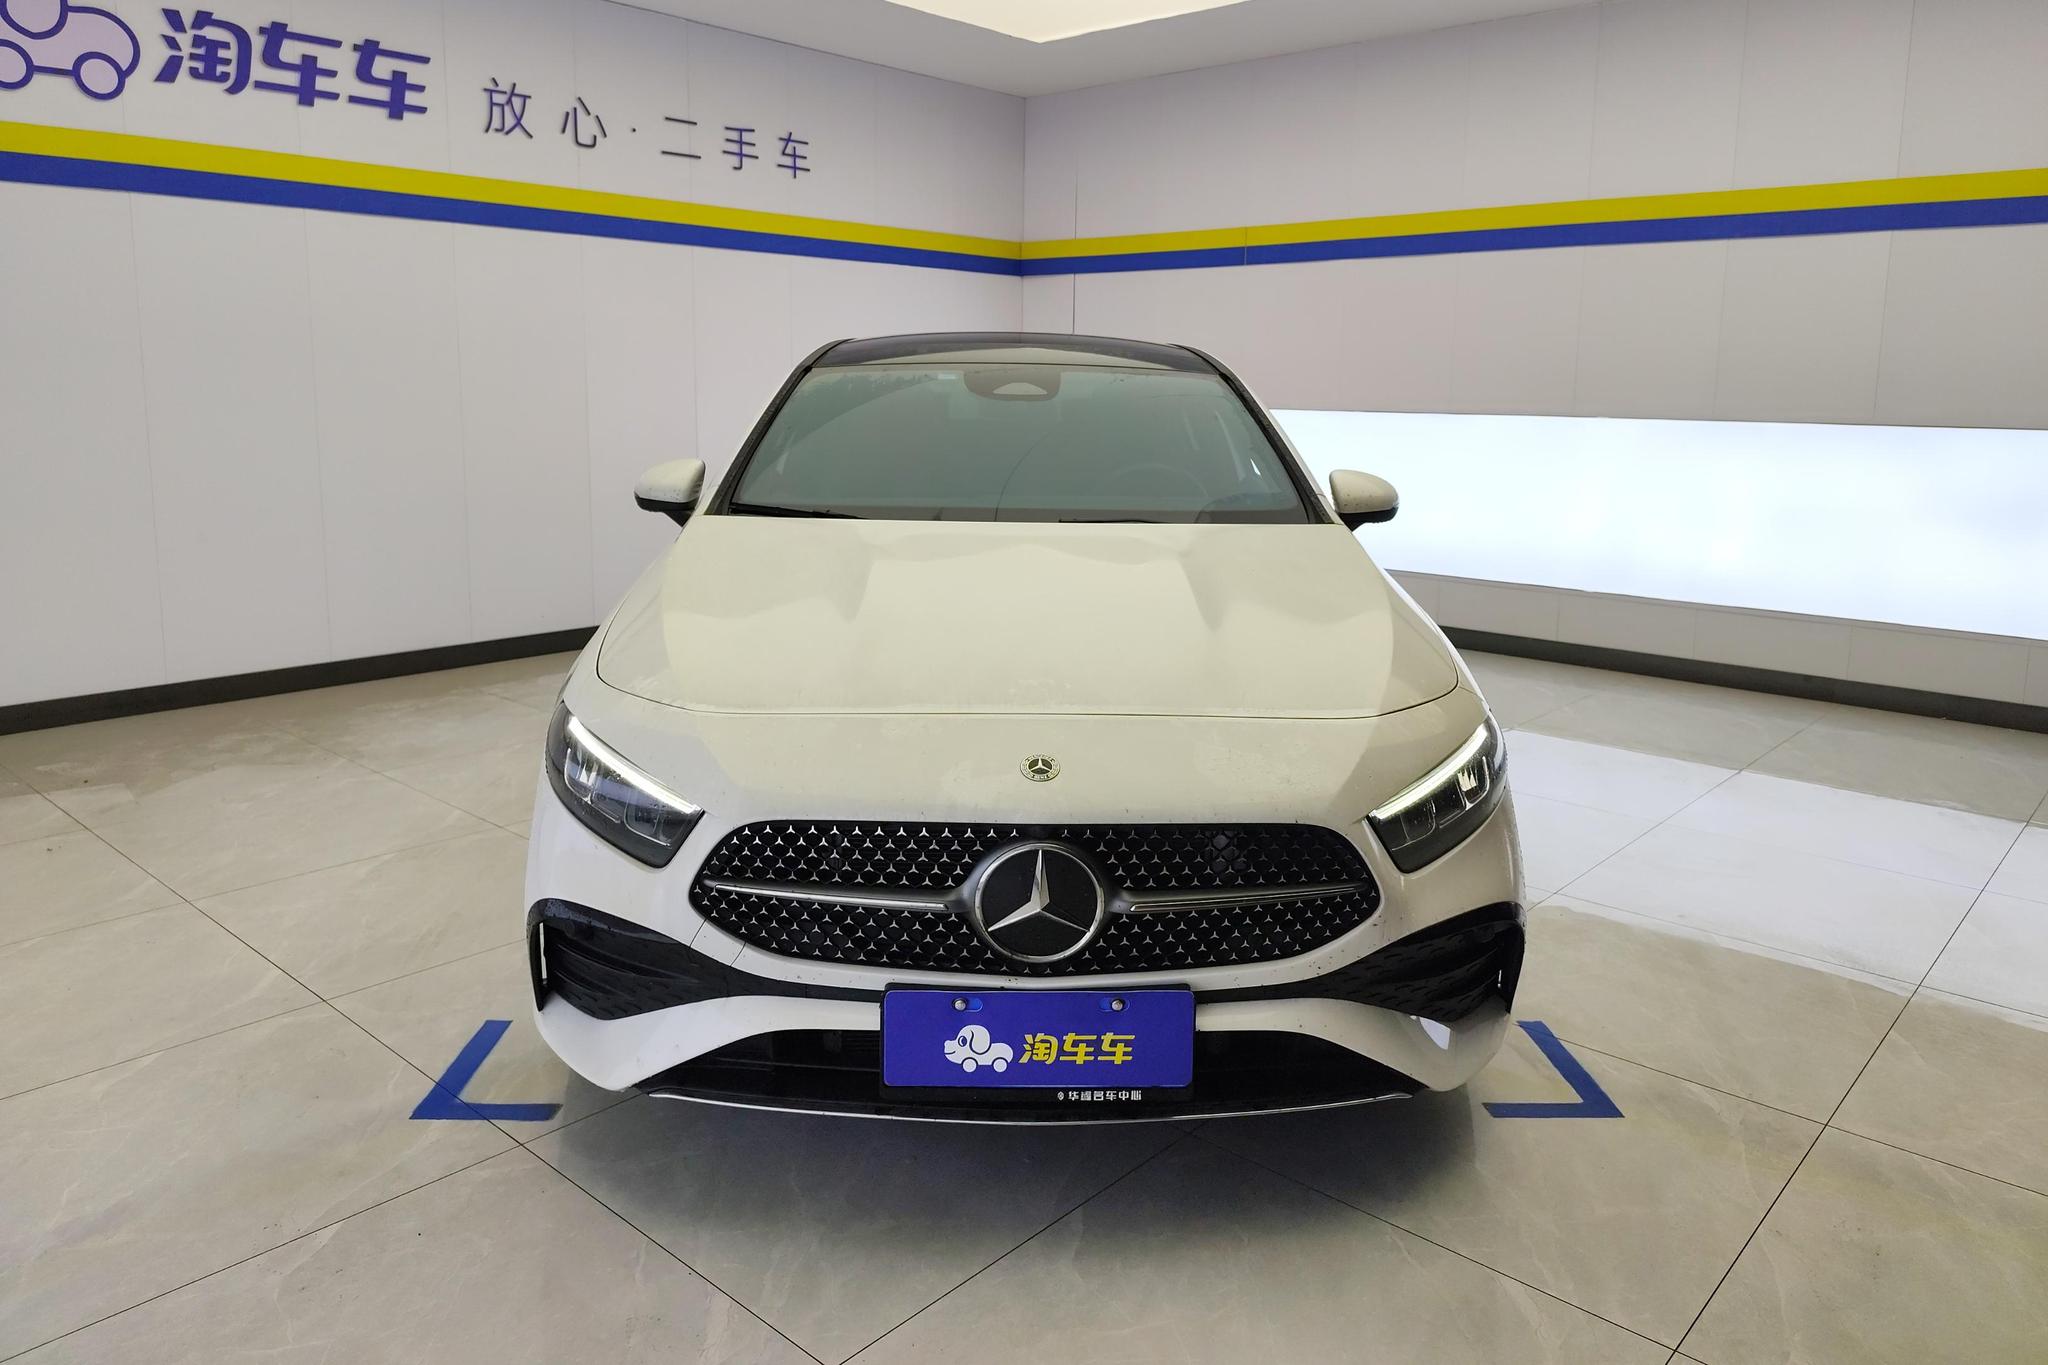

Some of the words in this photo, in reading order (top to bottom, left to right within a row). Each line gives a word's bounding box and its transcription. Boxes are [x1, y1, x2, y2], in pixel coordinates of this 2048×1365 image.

[153, 8, 431, 121] 淘车车
[1018, 1032, 1136, 1065] 淘车车
